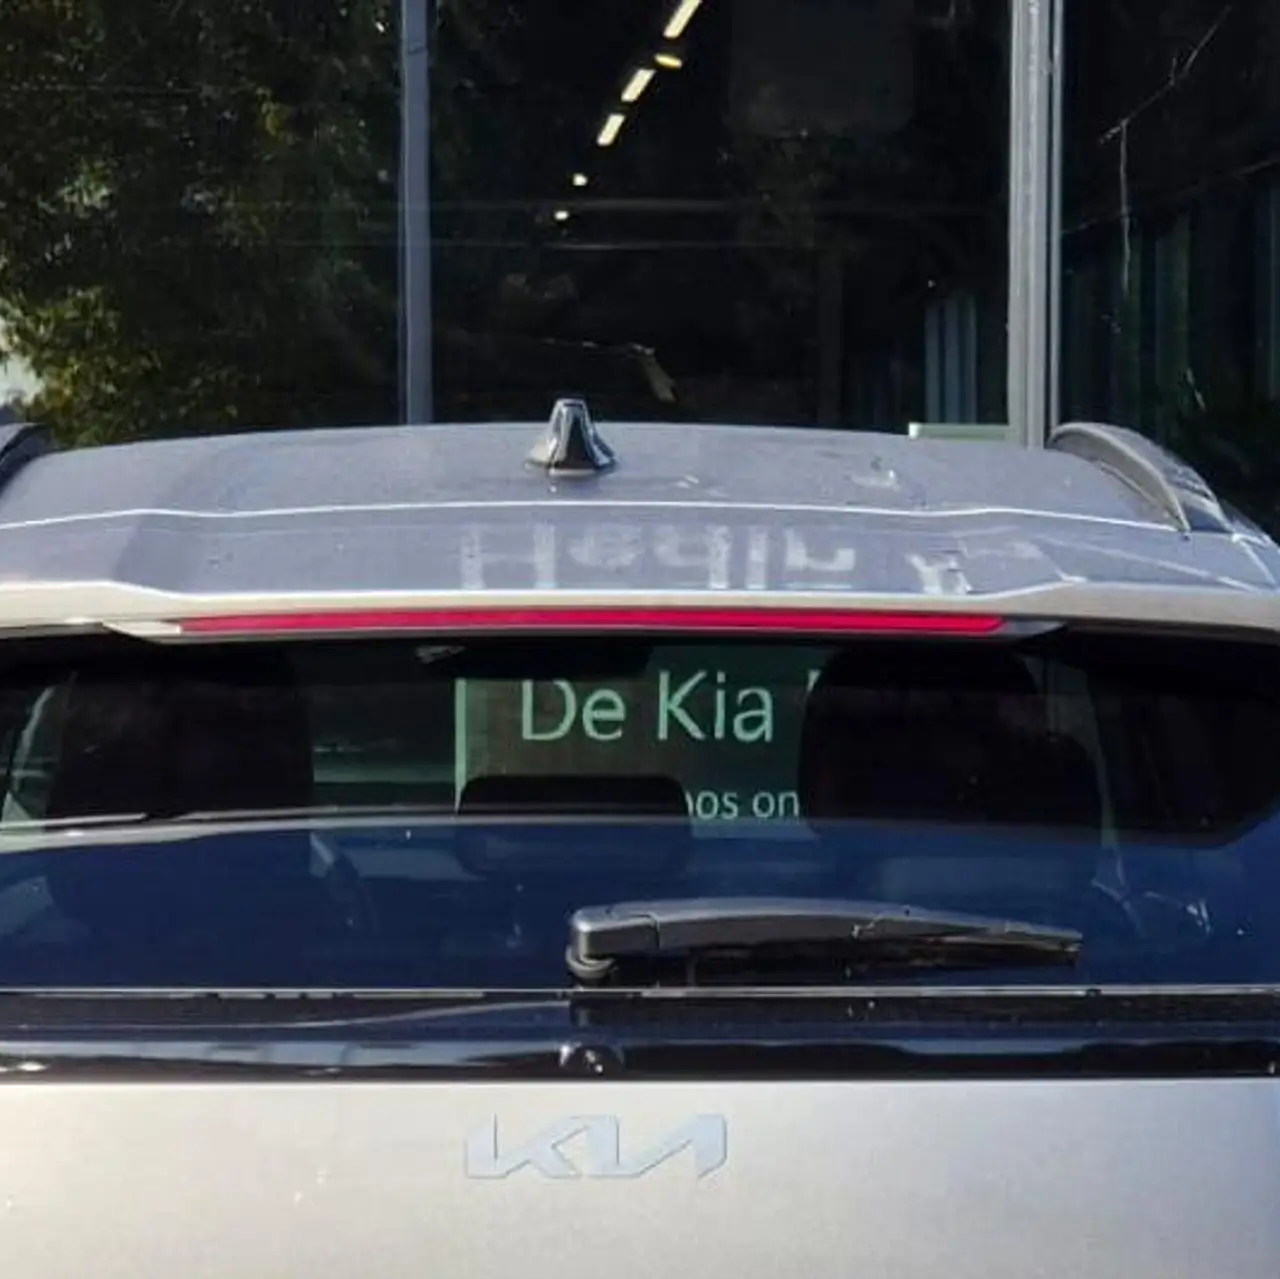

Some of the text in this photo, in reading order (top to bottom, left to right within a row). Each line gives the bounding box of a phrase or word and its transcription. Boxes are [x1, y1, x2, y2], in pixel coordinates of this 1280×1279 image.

[521, 670, 773, 742] De Kia
[464, 1114, 727, 1179] KIA
